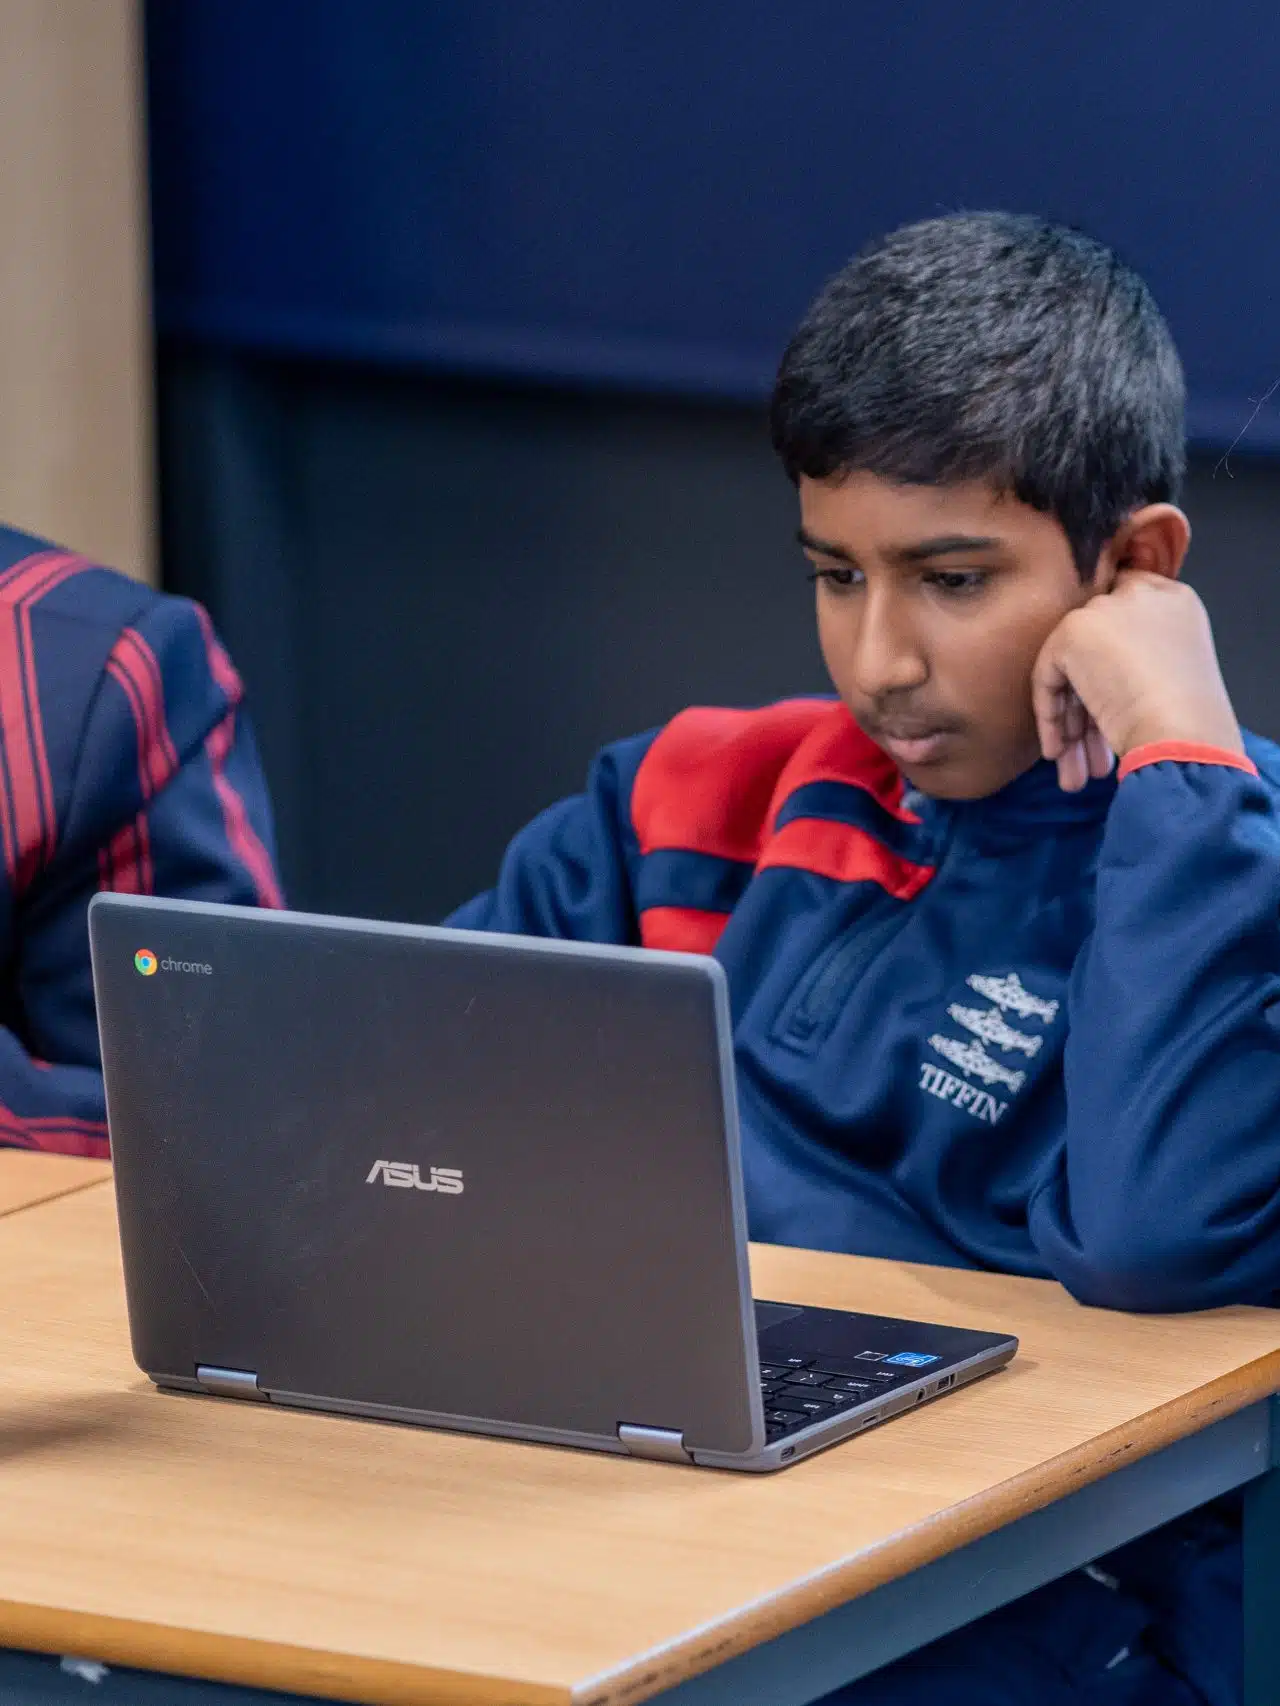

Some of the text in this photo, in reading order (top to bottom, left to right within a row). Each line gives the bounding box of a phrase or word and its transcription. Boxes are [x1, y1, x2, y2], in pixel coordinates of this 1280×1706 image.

[160, 956, 213, 975] chrome
[919, 1062, 1008, 1125] TIFFIN
[365, 1159, 464, 1195] ASUS
